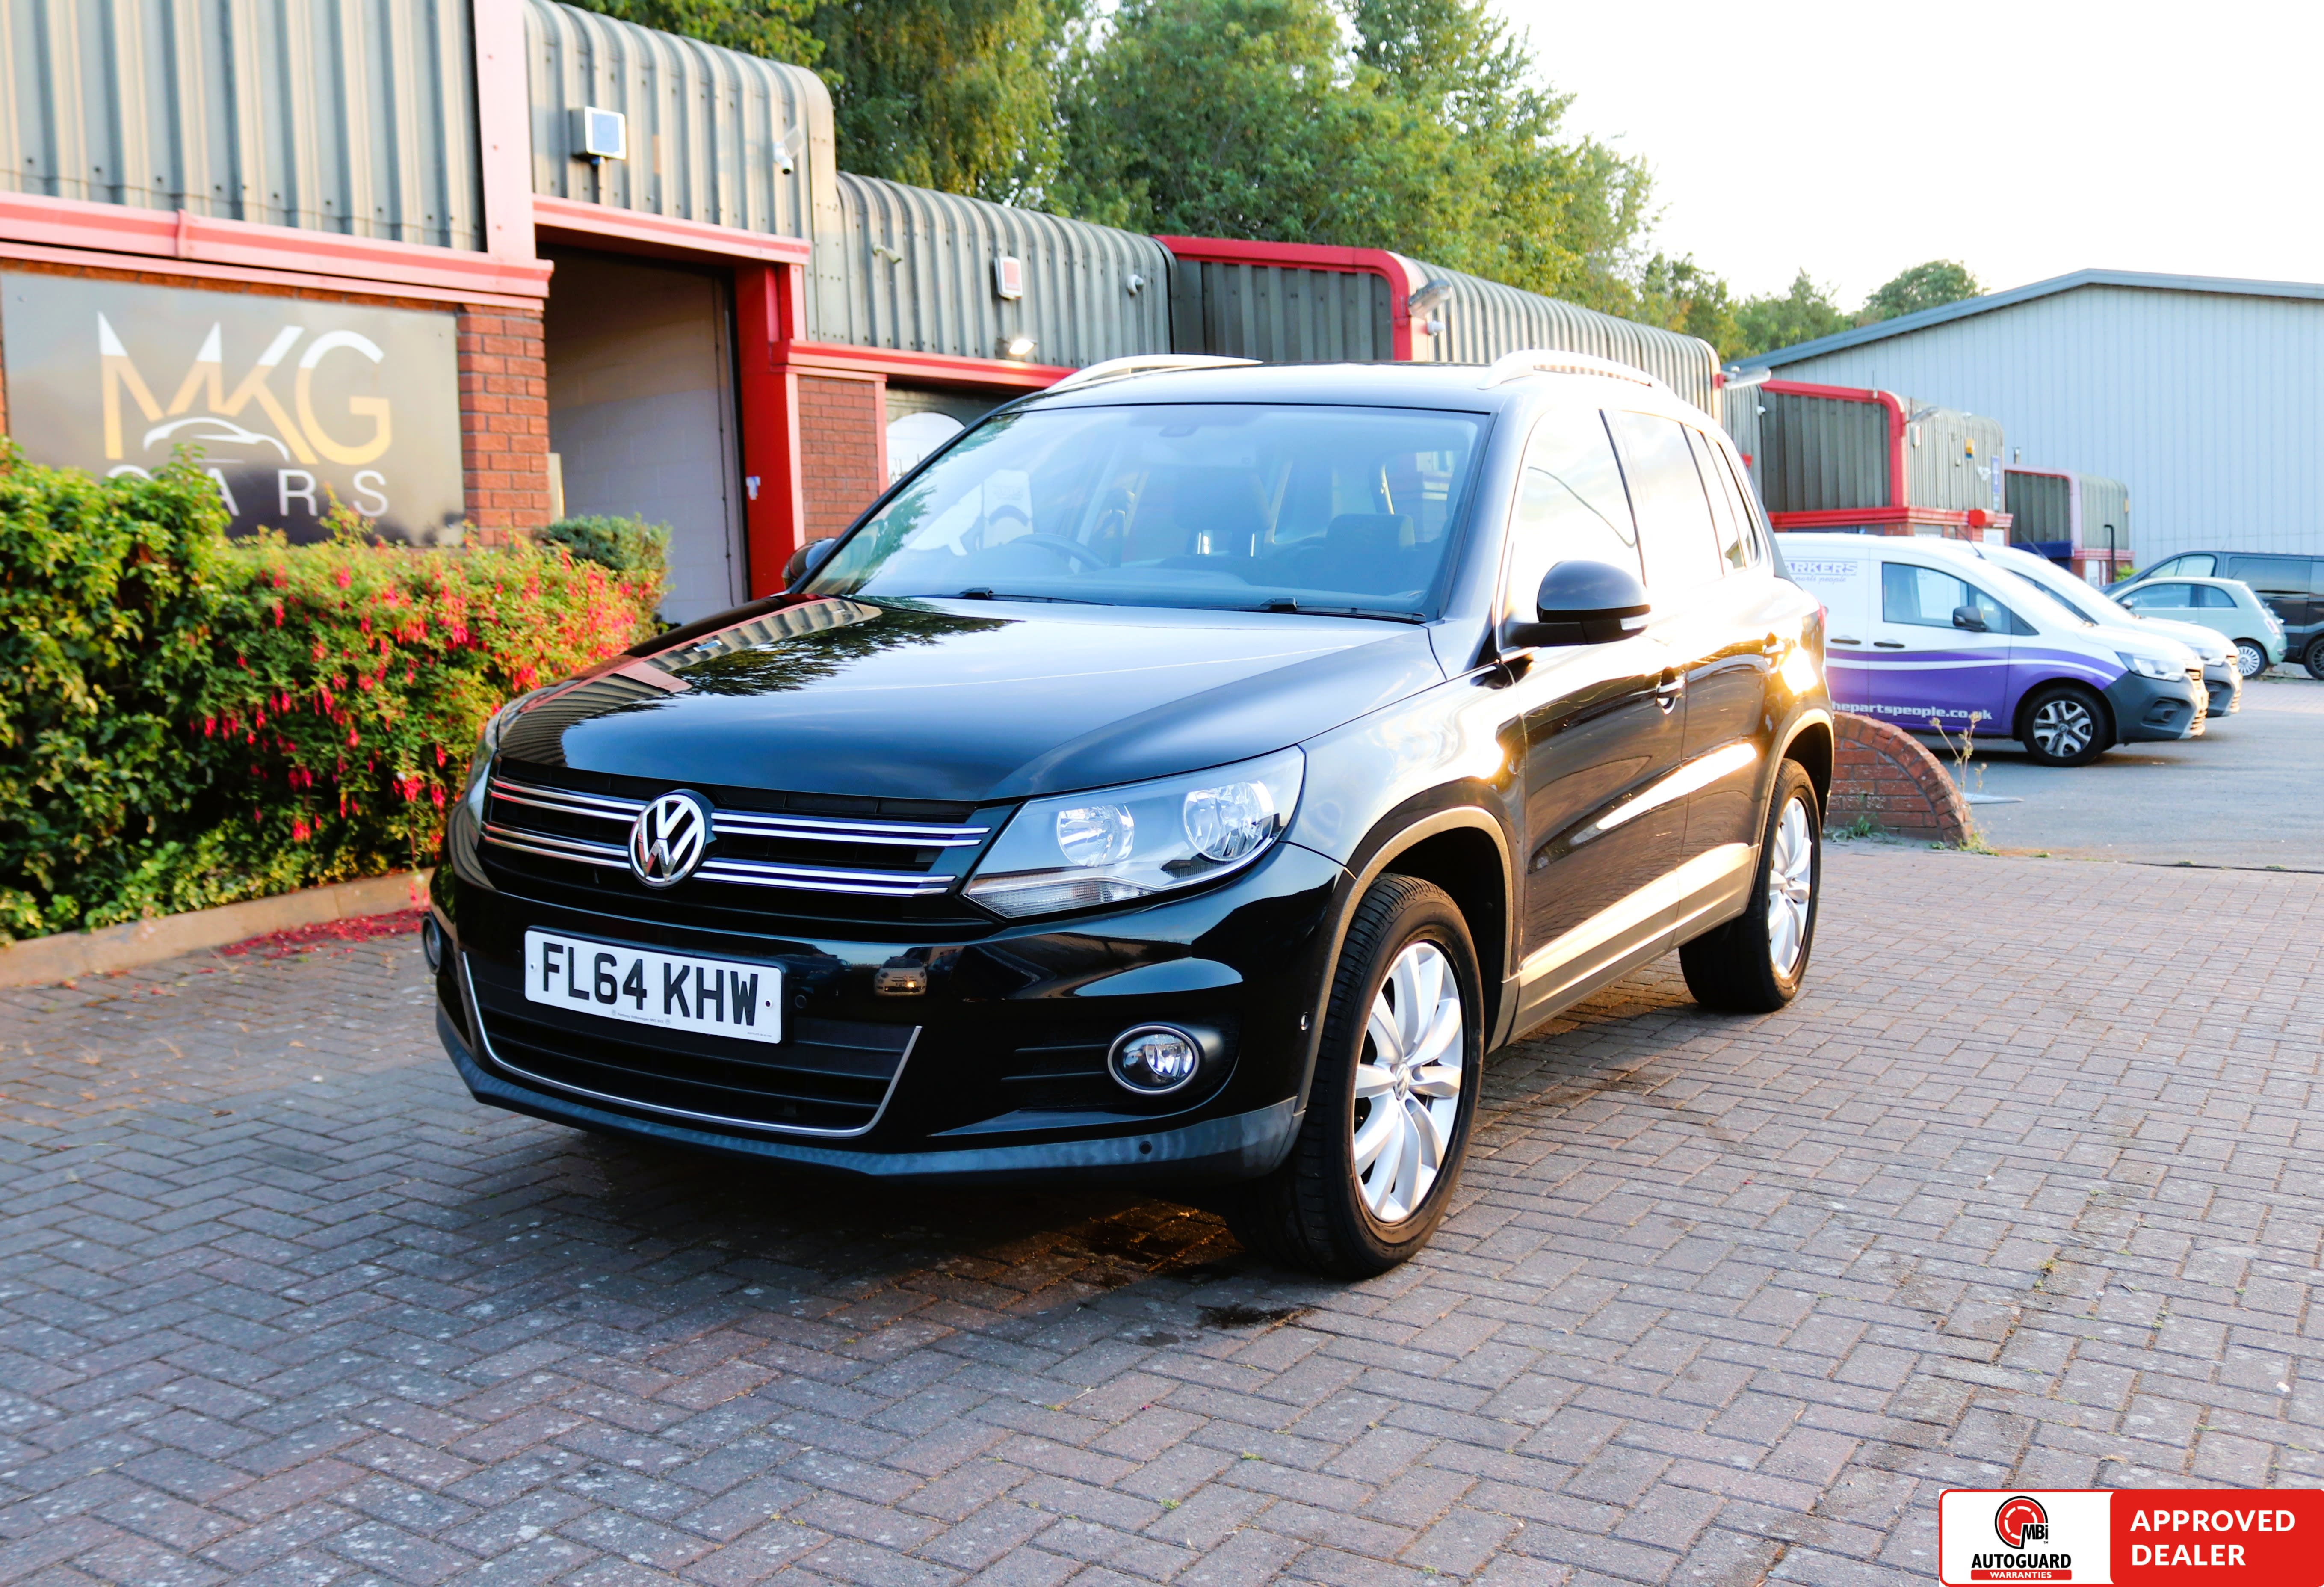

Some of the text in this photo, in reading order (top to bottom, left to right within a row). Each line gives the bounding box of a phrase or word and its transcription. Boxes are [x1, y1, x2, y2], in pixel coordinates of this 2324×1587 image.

[98, 311, 392, 466] MKG
[1832, 701, 1993, 720] hepartspeople.co.k
[543, 942, 758, 1026] FL64 KHW
